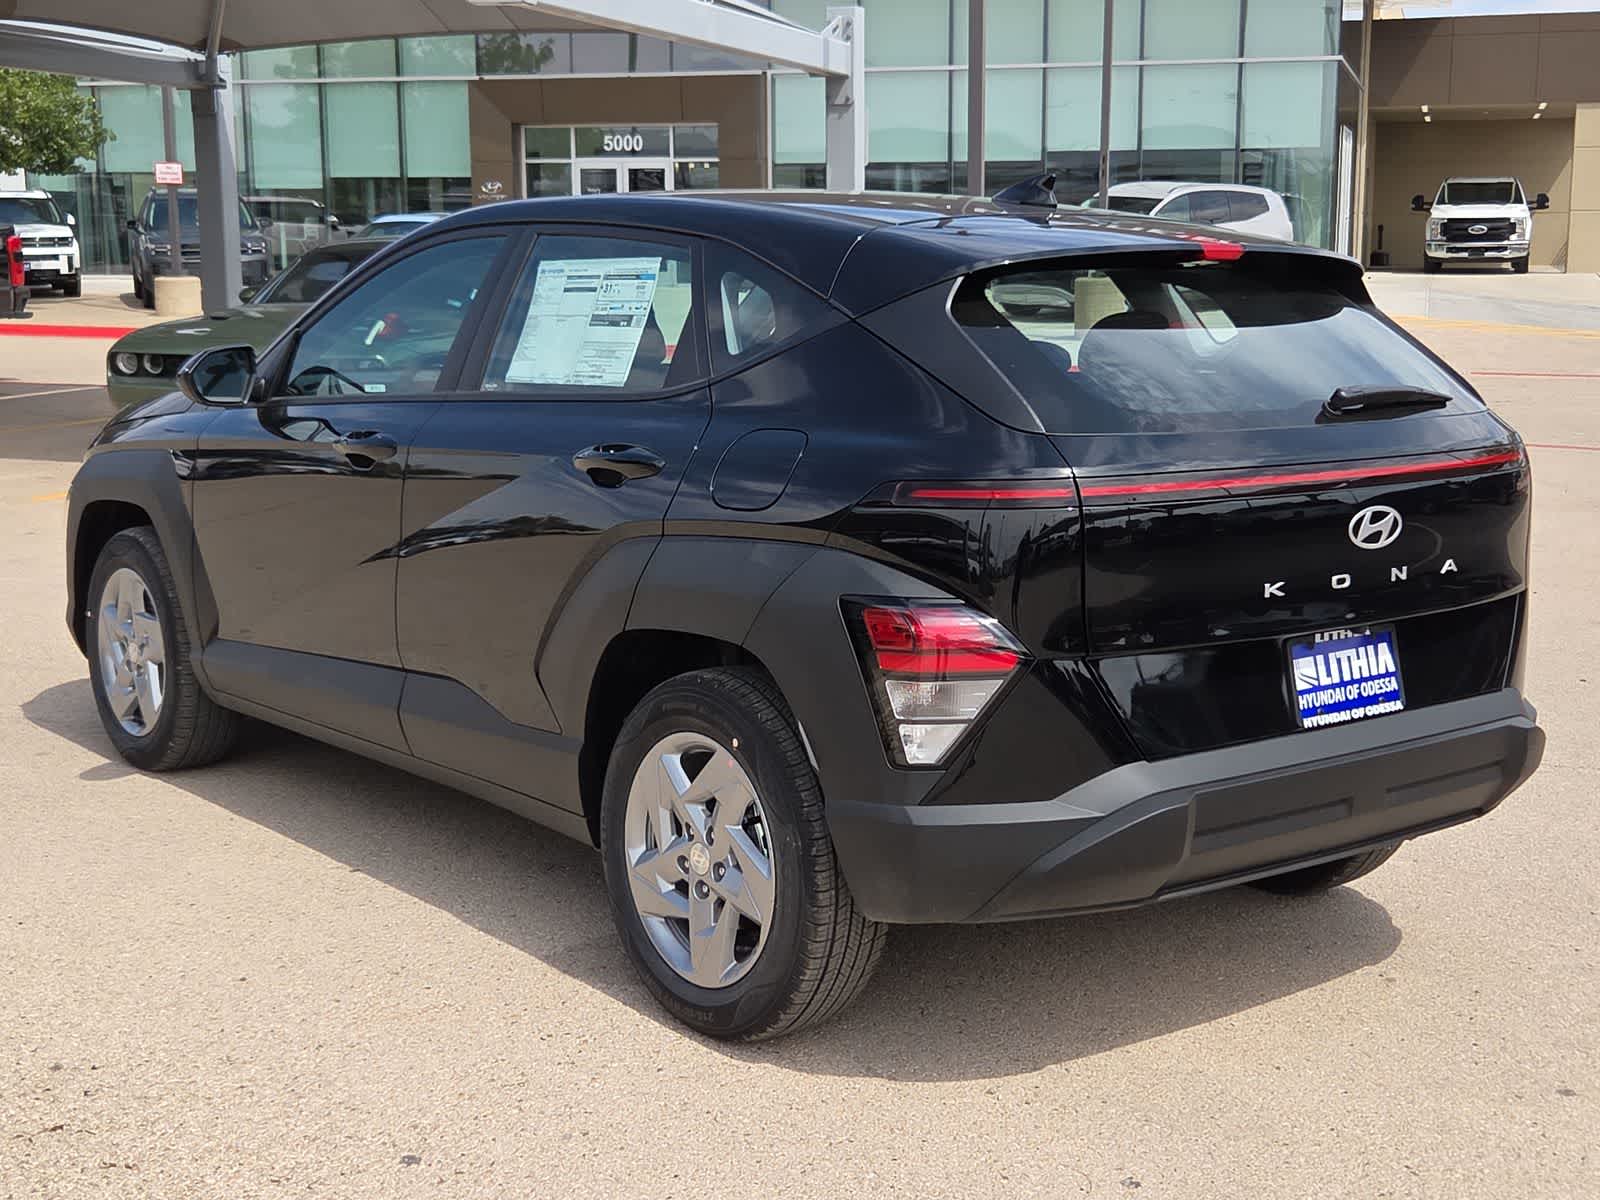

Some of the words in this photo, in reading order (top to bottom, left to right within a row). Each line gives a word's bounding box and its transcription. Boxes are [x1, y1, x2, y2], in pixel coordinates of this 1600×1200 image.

[603, 135, 644, 152] 5000
[1263, 558, 1458, 598] KONA
[1315, 629, 1371, 643] LITHA
[1316, 642, 1396, 686] LITHIA
[1298, 687, 1346, 710] HYUNDAI
[1346, 684, 1360, 701] OF
[1361, 677, 1399, 697] ODESSA
[1303, 710, 1351, 729] HYUNDAI
[1351, 706, 1365, 719] OF
[1365, 700, 1404, 717] ODESSA
